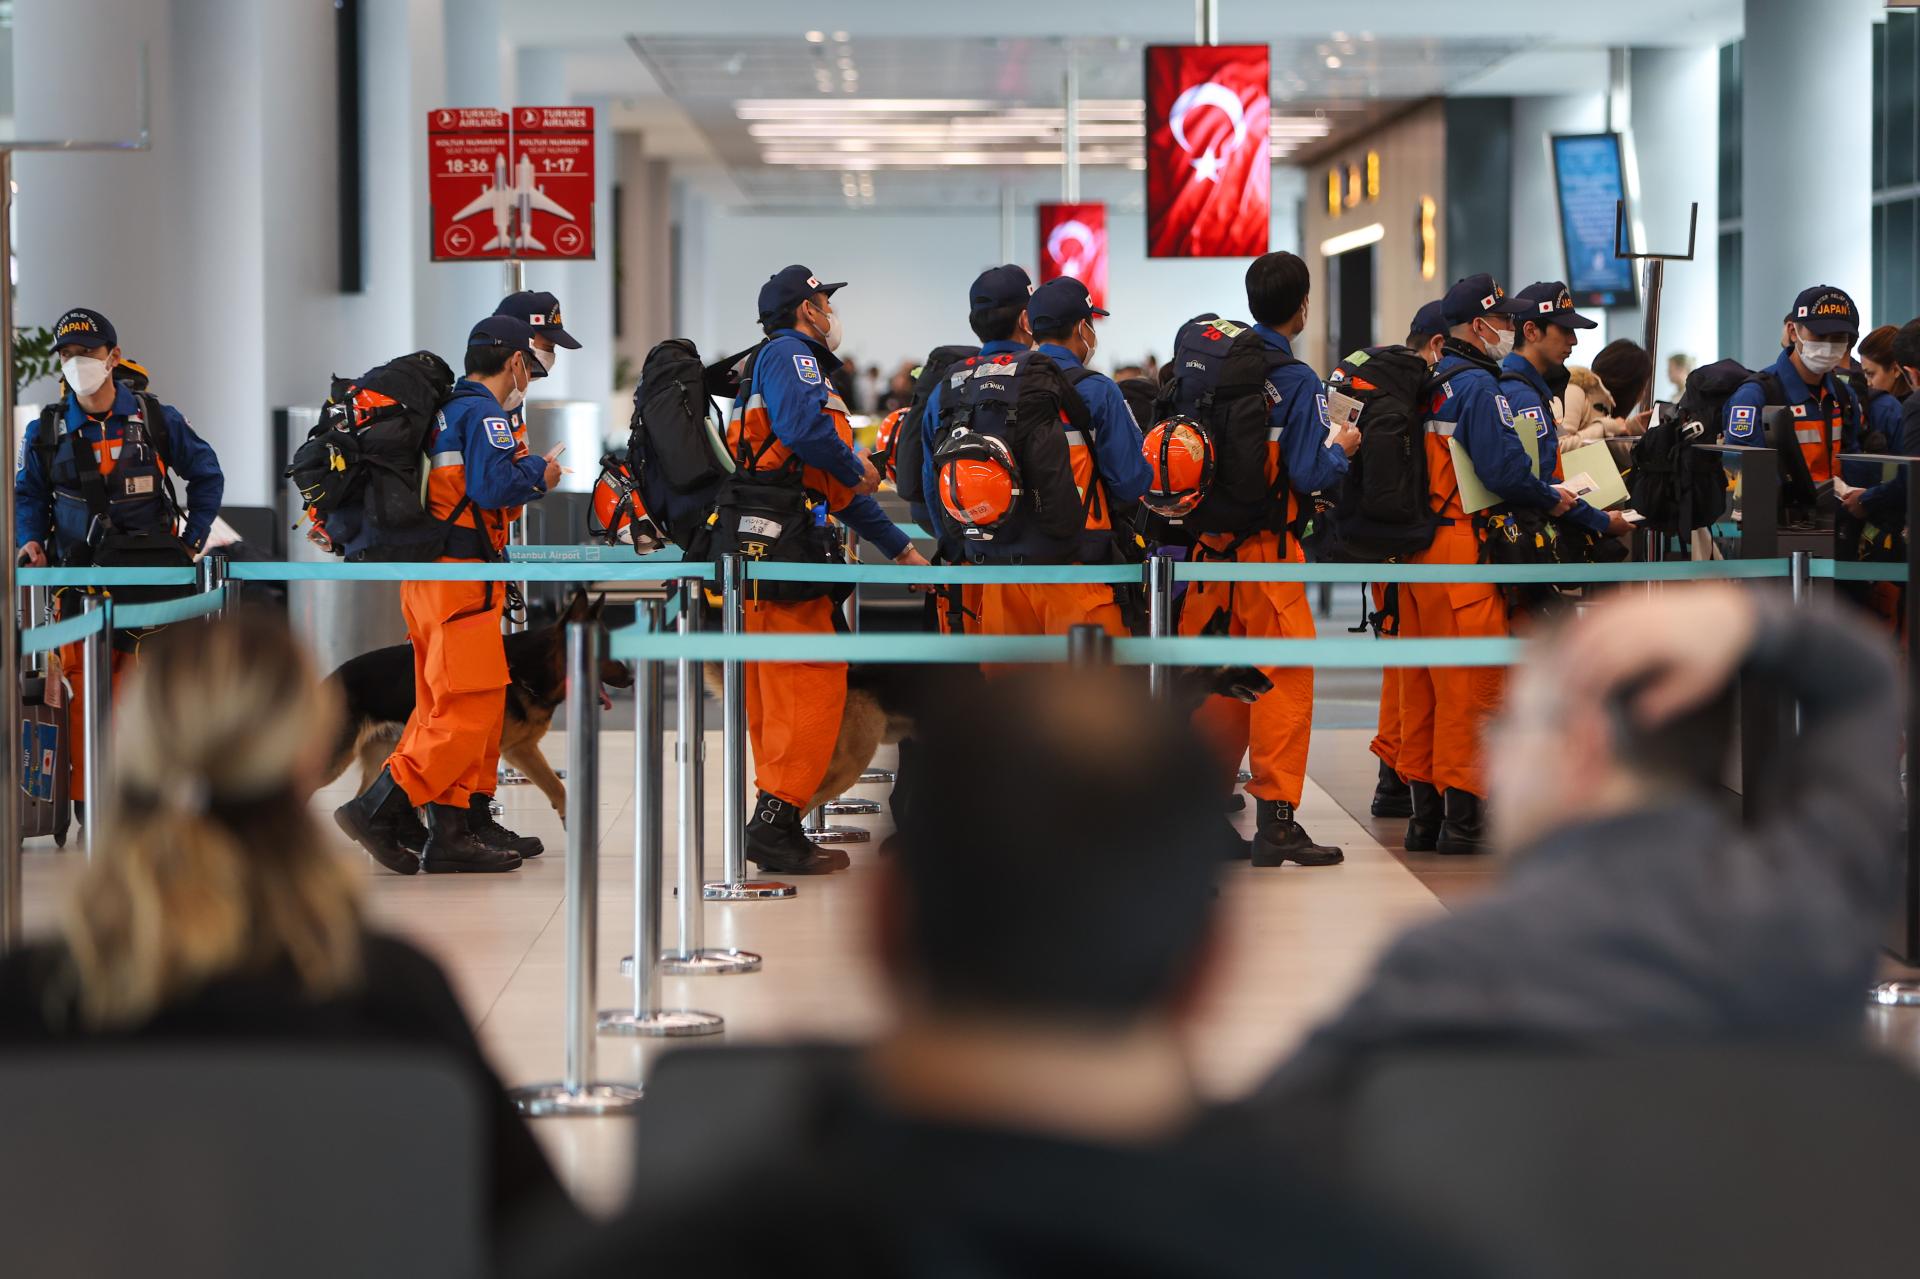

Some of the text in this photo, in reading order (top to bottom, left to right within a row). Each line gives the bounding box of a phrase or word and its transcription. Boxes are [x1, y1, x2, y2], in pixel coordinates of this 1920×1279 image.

[459, 110, 501, 118] TURKISH
[543, 109, 586, 118] TURKISH
[459, 119, 503, 127] AIRLINES
[543, 118, 586, 127] AIRLINES
[445, 159, 489, 172] 18-36
[542, 158, 575, 172] 1-17
[1818, 304, 1847, 315] JAPAN
[60, 322, 89, 336] JAPAN
[548, 550, 580, 560] Airport
